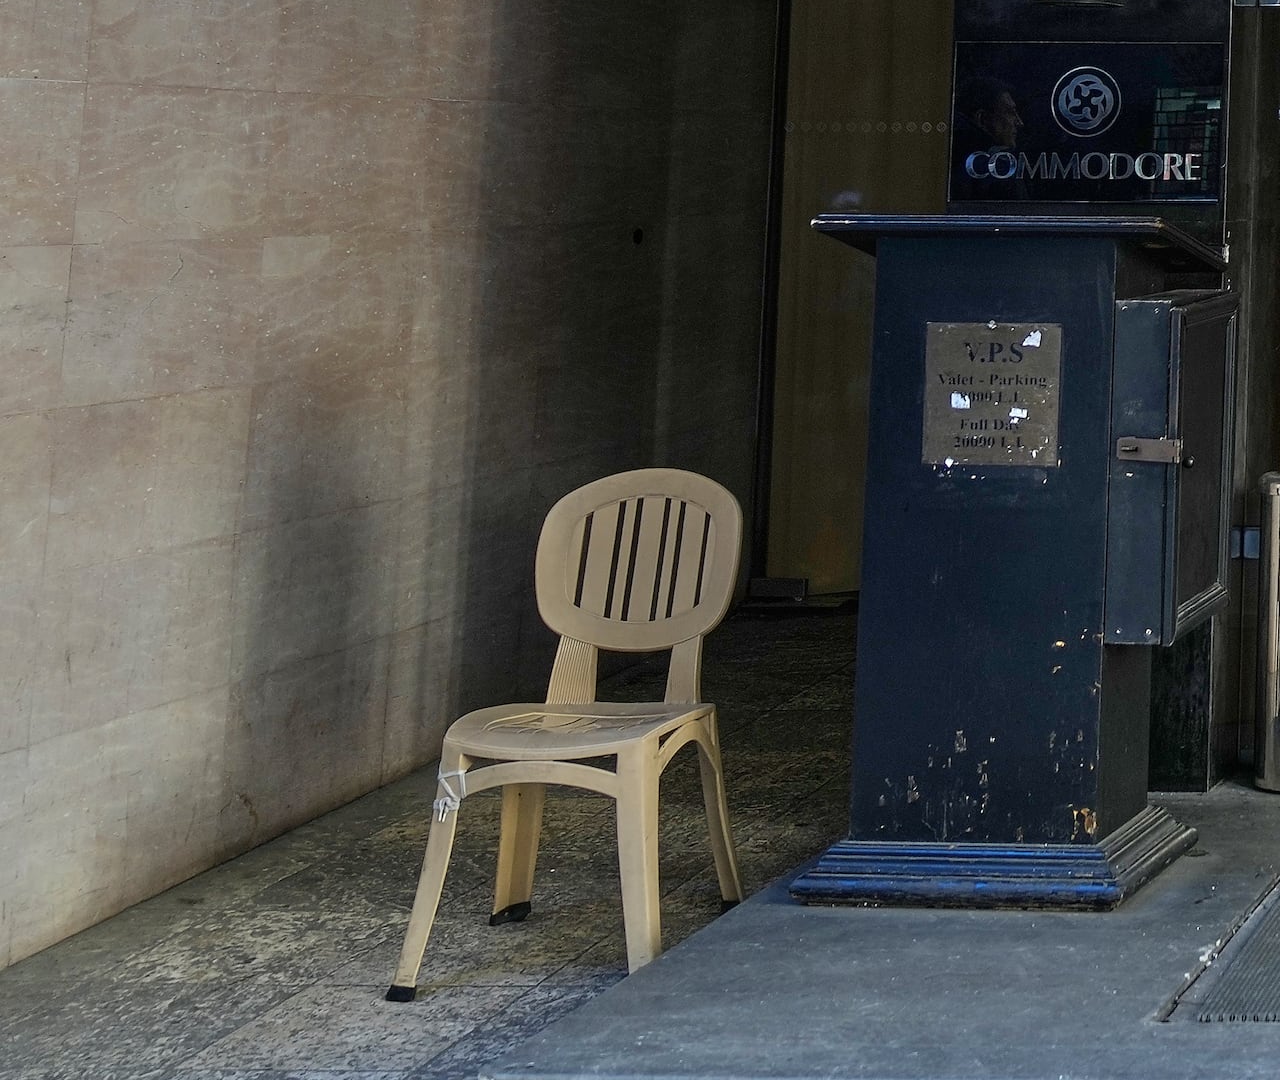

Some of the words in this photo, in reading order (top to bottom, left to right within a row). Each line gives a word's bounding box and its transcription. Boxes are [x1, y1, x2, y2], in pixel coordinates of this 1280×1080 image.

[965, 151, 1202, 180] COMMODORE
[964, 342, 1024, 363] V.P.S
[938, 374, 974, 385] Valet
[989, 374, 1047, 388] Parking
[960, 419, 988, 431] Full
